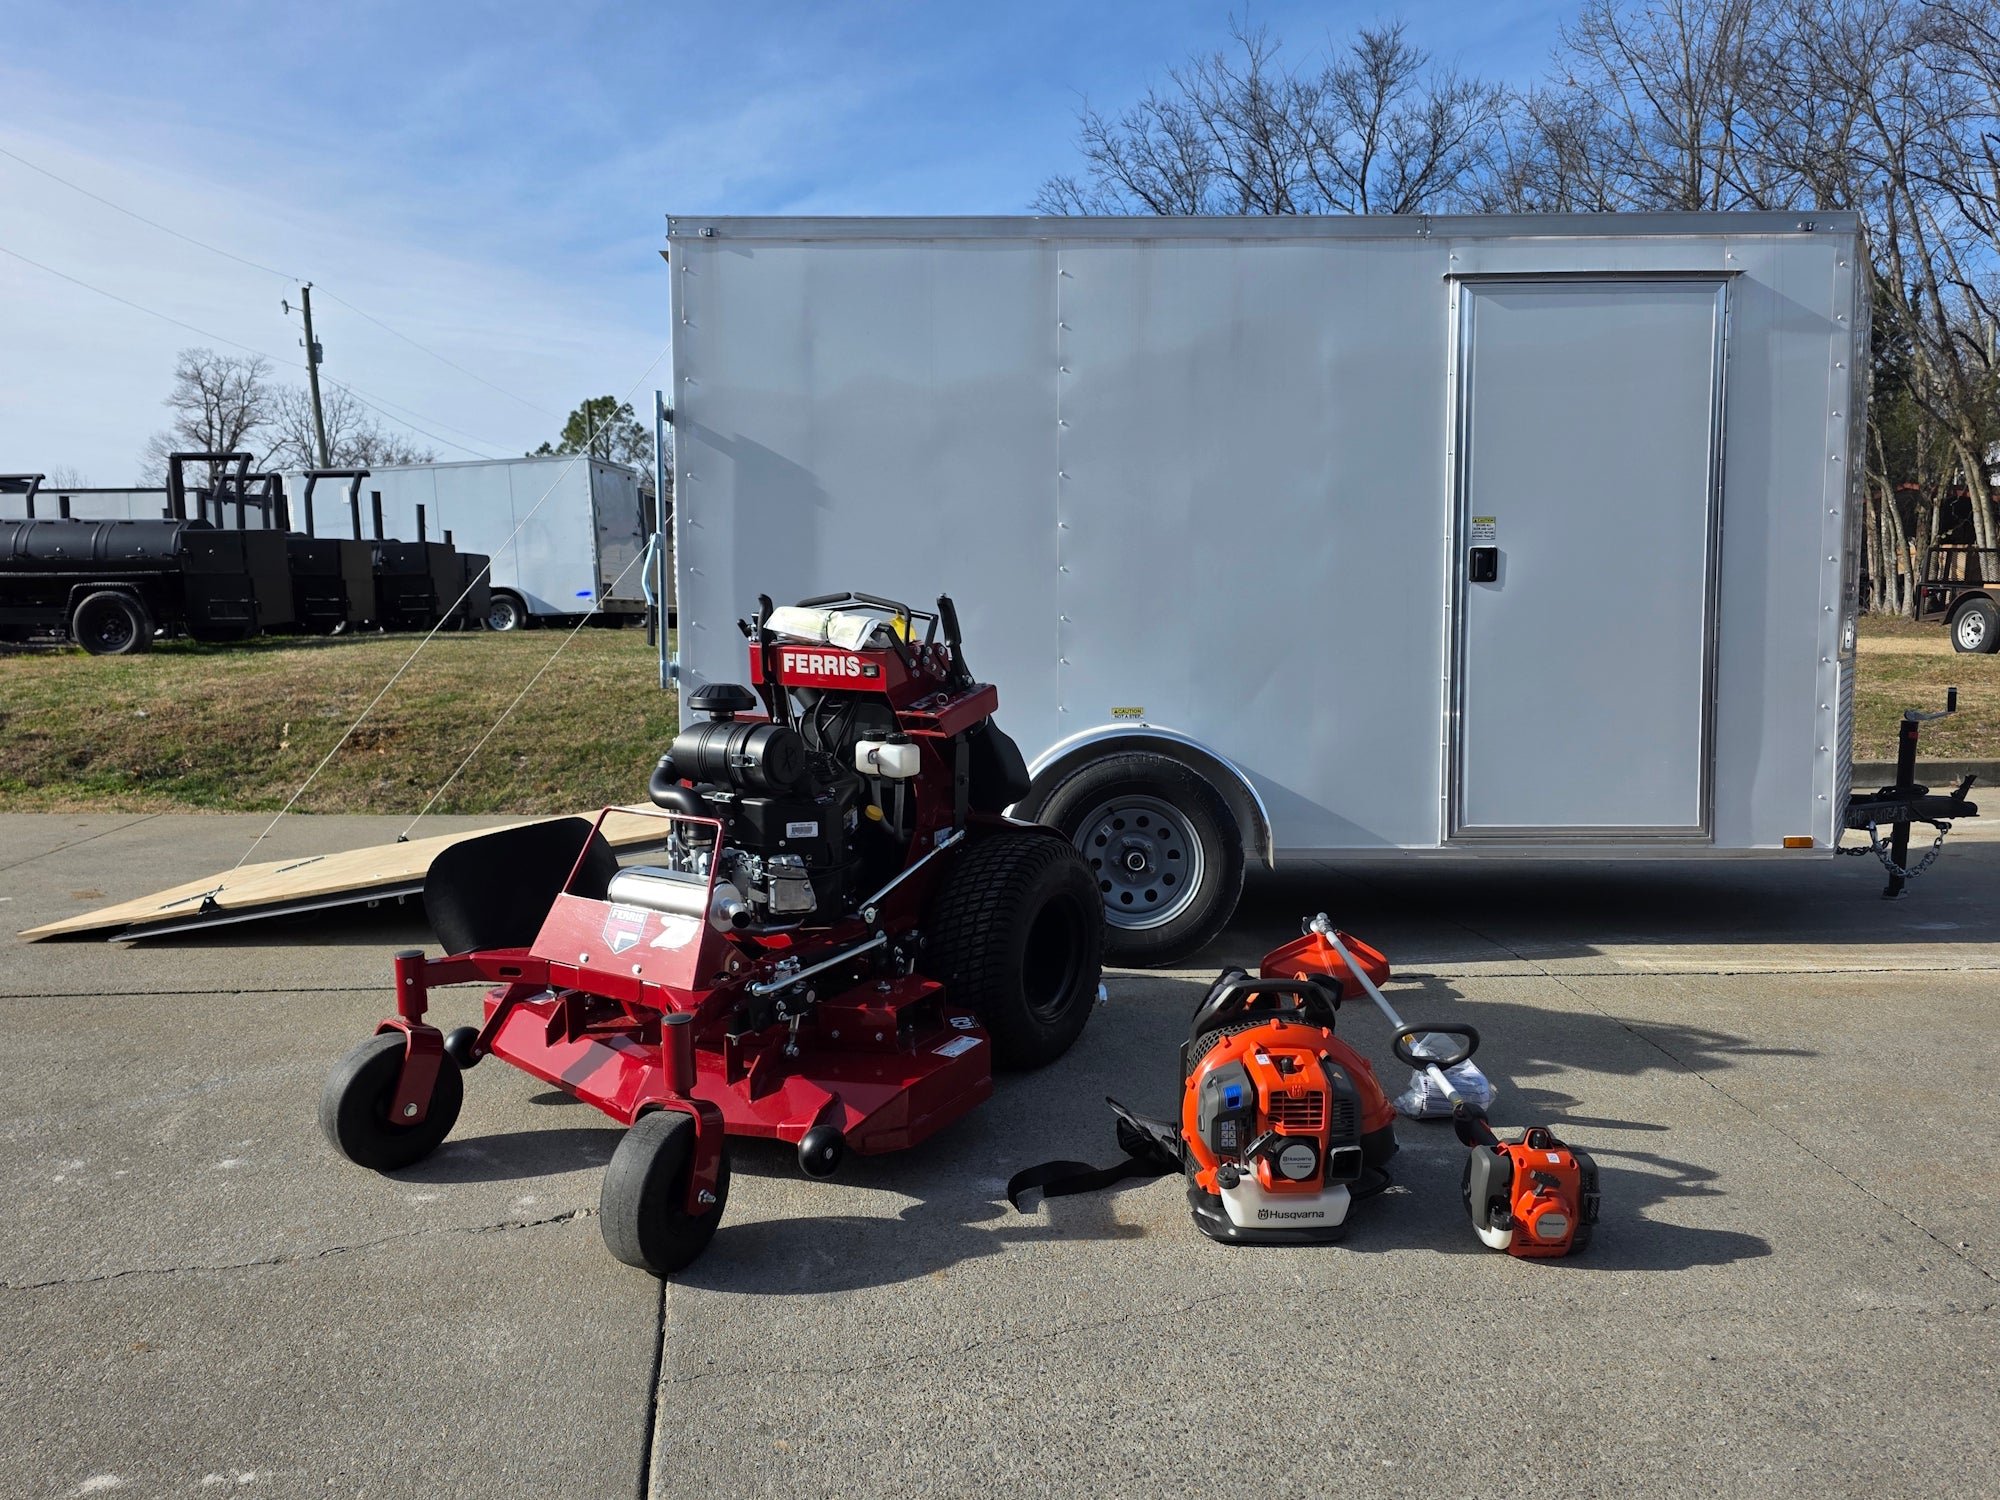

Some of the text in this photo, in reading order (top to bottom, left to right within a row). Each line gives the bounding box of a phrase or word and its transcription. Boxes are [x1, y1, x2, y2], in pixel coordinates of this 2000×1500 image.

[783, 652, 861, 677] FERRIS
[611, 908, 646, 923] FERRIS
[1270, 1210, 1325, 1220] Husqvarna
